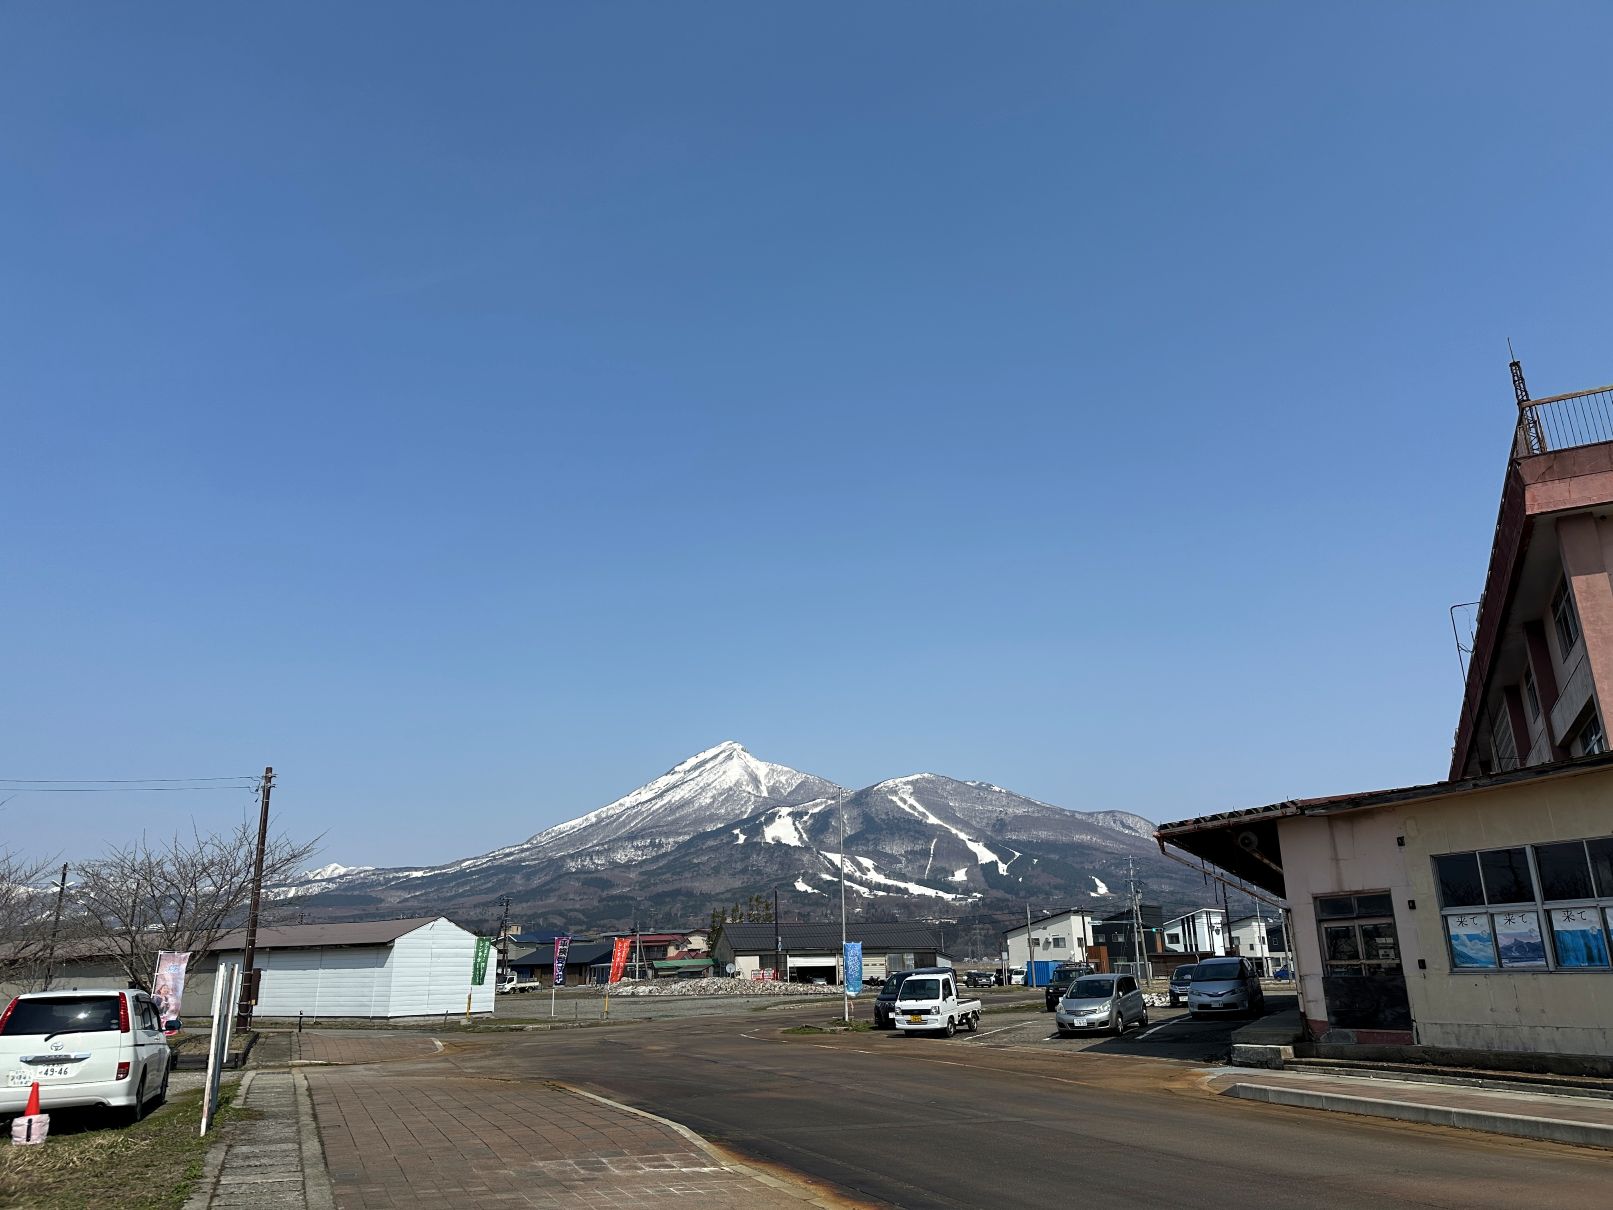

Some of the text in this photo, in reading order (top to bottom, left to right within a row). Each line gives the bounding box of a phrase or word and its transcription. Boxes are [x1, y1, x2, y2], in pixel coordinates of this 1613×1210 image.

[1456, 916, 1478, 927] 来て
[1504, 912, 1527, 925] 来て
[1562, 910, 1587, 923] 来て
[43, 1067, 69, 1077] 49-46
